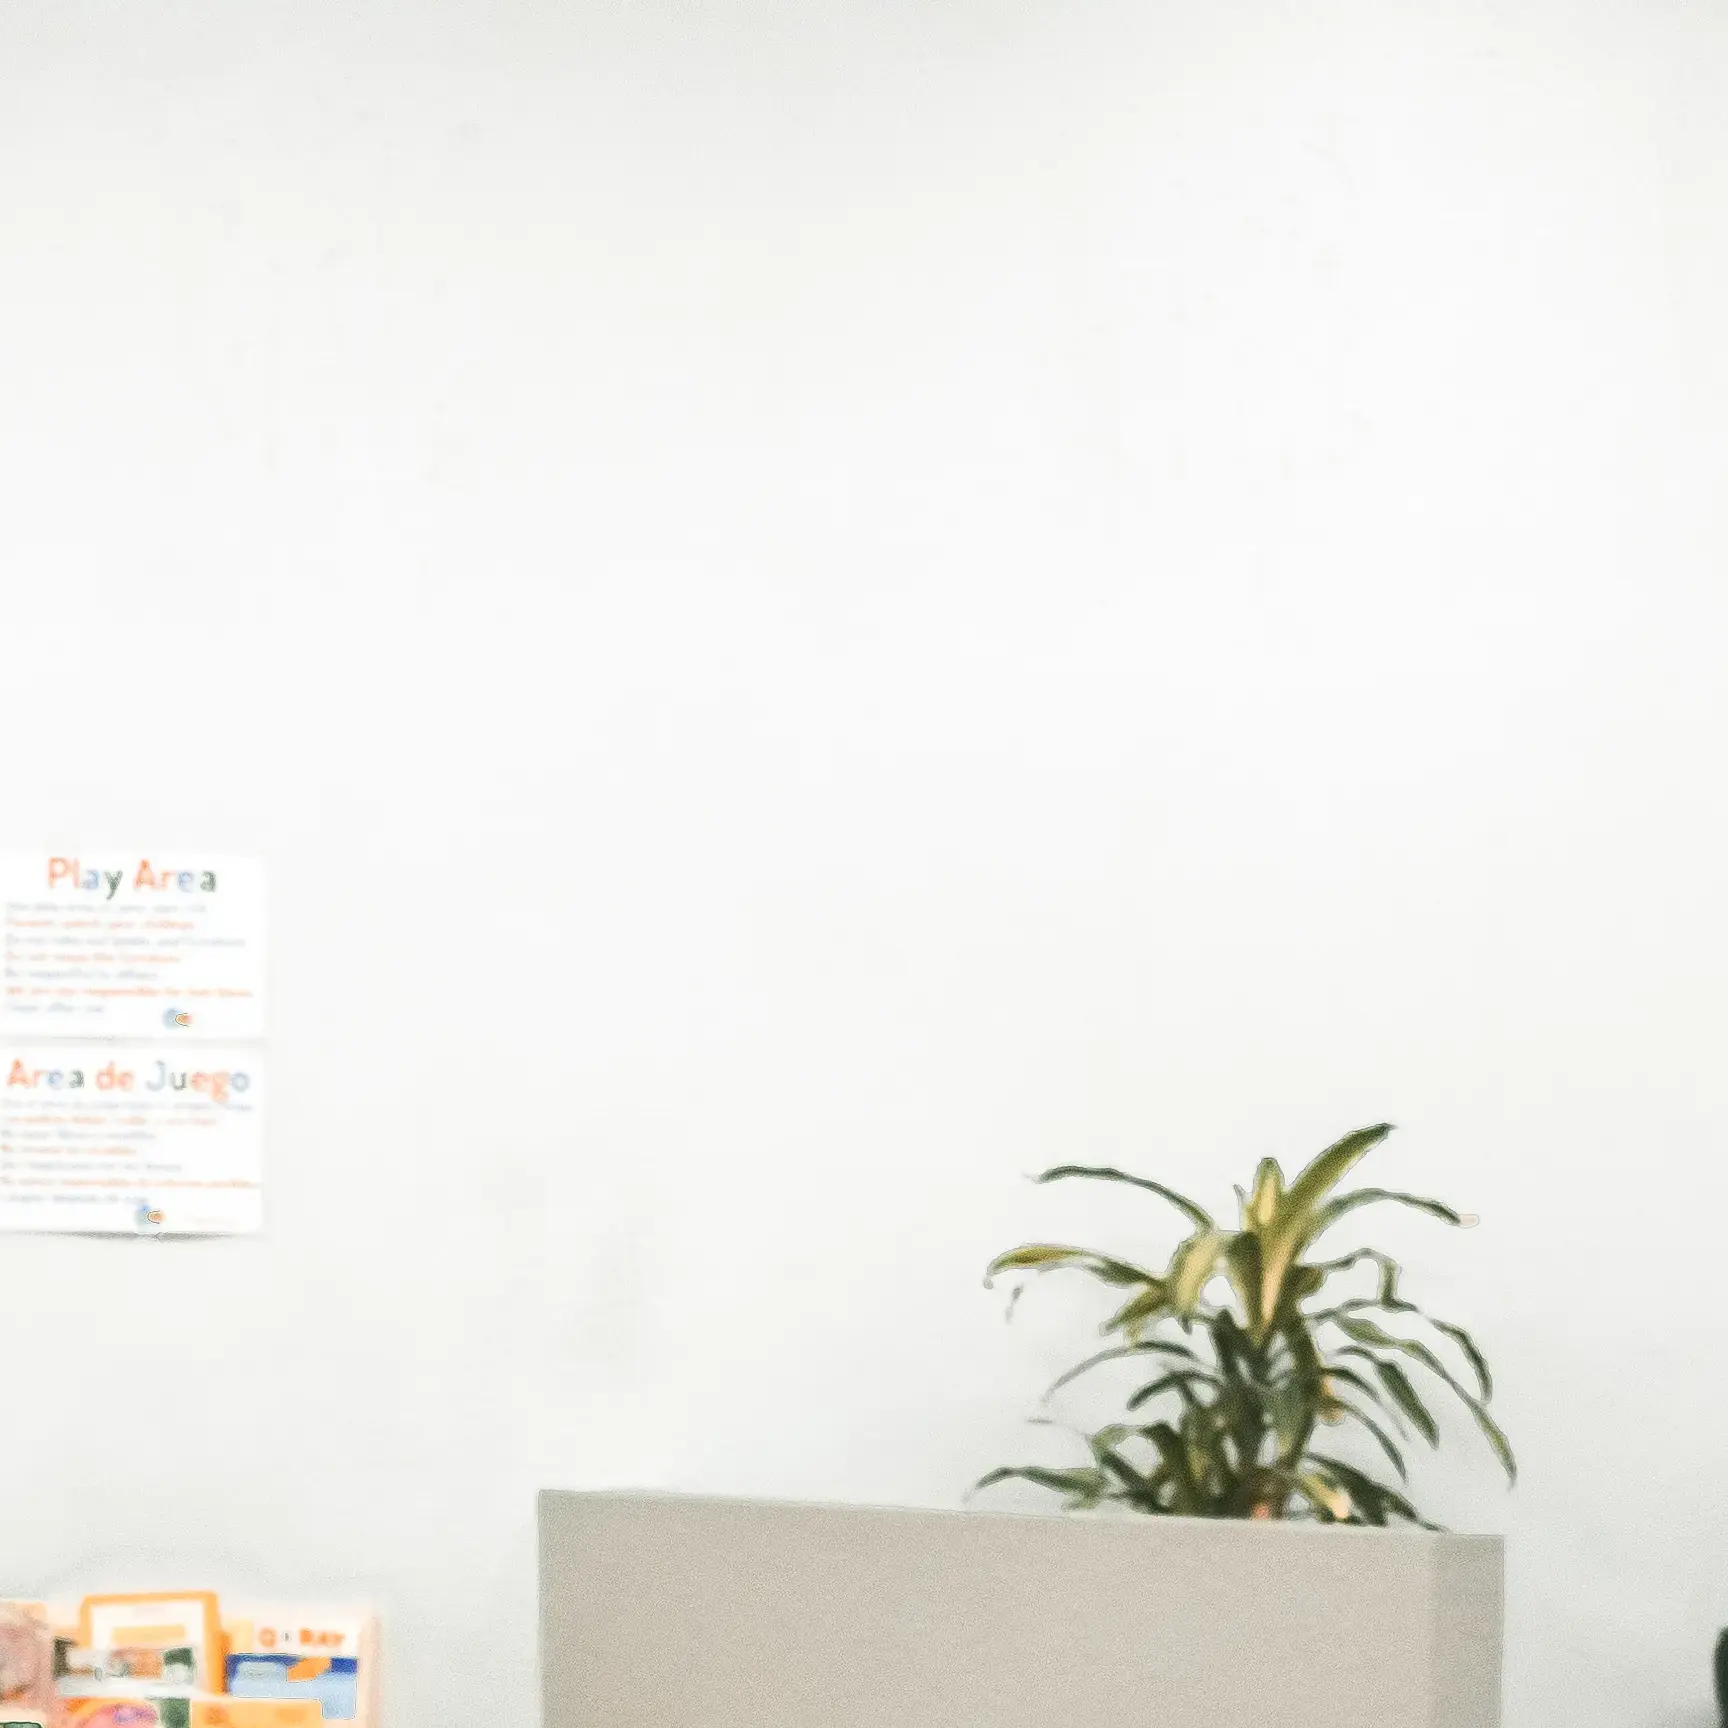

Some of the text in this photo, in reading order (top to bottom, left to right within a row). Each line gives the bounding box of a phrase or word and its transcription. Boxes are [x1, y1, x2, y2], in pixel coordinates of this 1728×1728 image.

[47, 857, 217, 900] Play Area
[6, 1058, 250, 1101] Area de Juego
